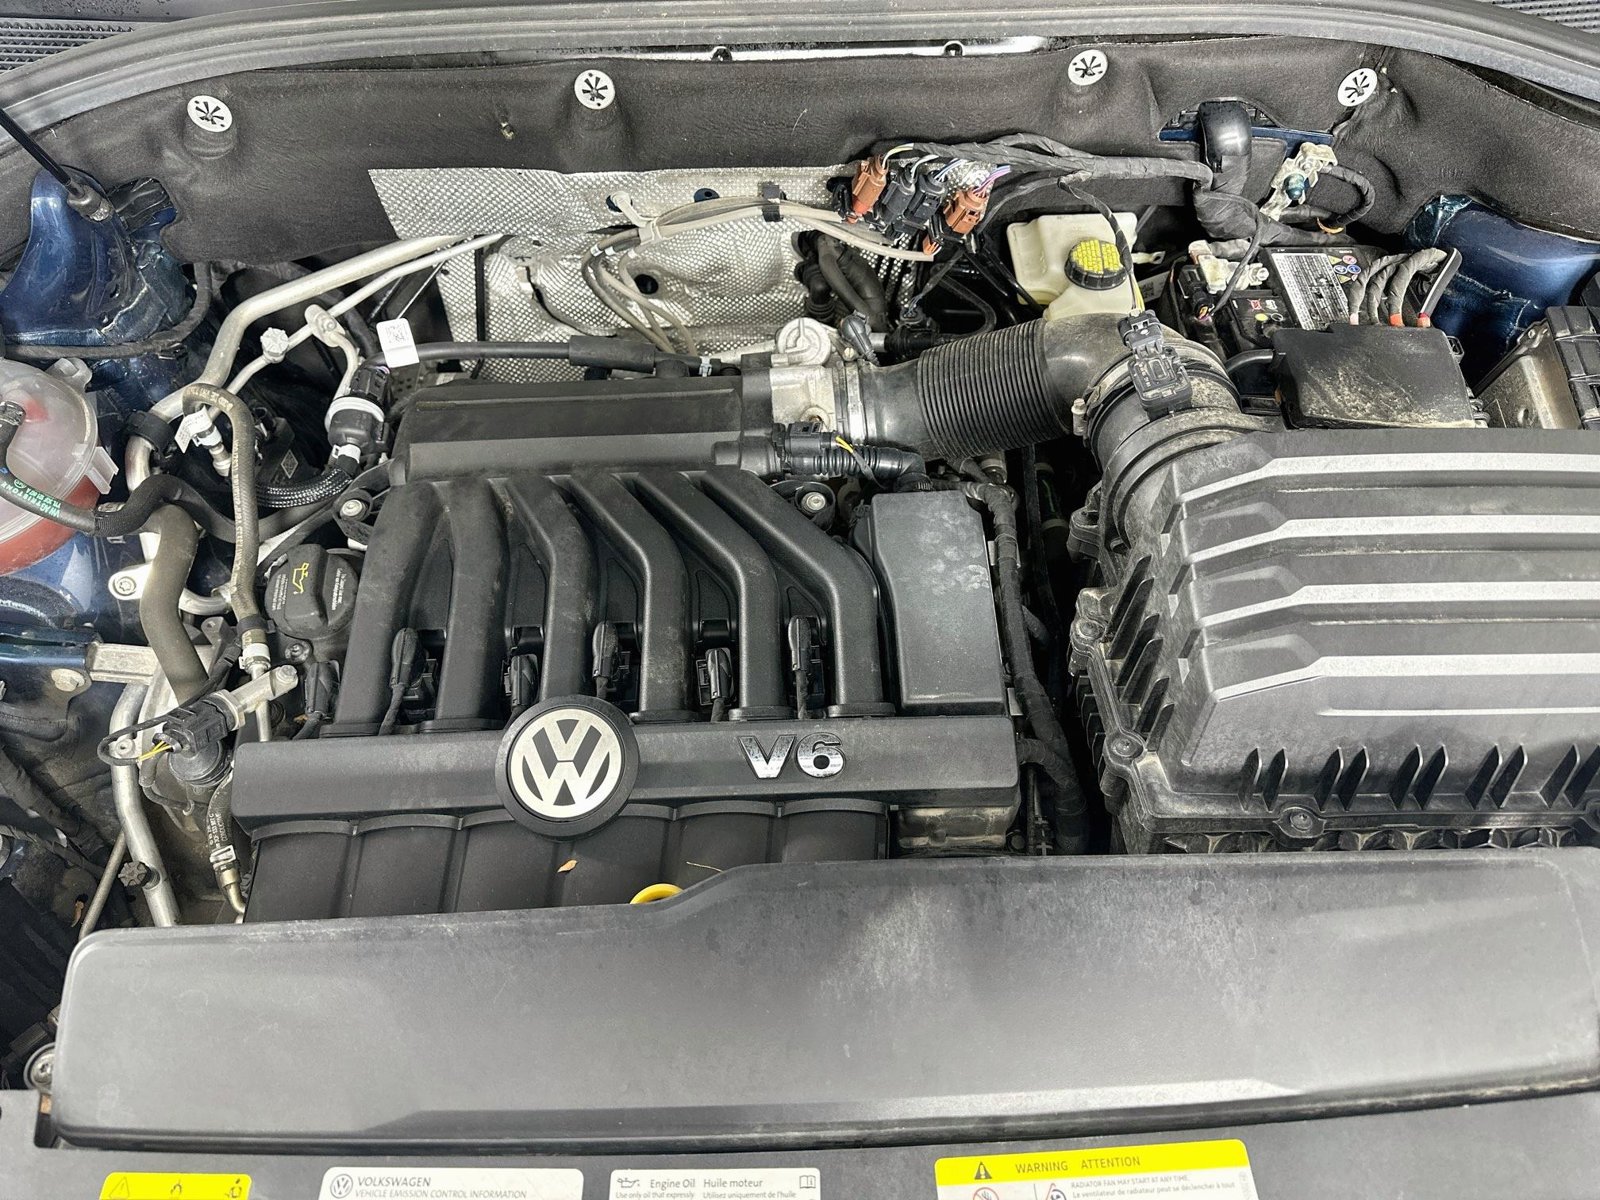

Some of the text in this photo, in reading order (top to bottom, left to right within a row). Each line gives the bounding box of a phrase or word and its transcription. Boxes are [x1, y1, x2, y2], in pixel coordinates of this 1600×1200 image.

[738, 732, 845, 779] V6
[1015, 1156, 1141, 1174] WARNING ATTENTION
[357, 1176, 431, 1187] VOLKSWAGEN
[650, 1178, 696, 1191] Engine Oil
[703, 1178, 763, 1188] Huile moteur
[1071, 1180, 1102, 1189] RADIATOR
[1103, 1179, 1116, 1187] FAN
[1131, 1177, 1150, 1185] START
[355, 1190, 527, 1198] VEHICLE EMISSION CONTROL INFORMATION
[1082, 1190, 1116, 1198] ventilateur
[1127, 1187, 1155, 1195] radiateur
